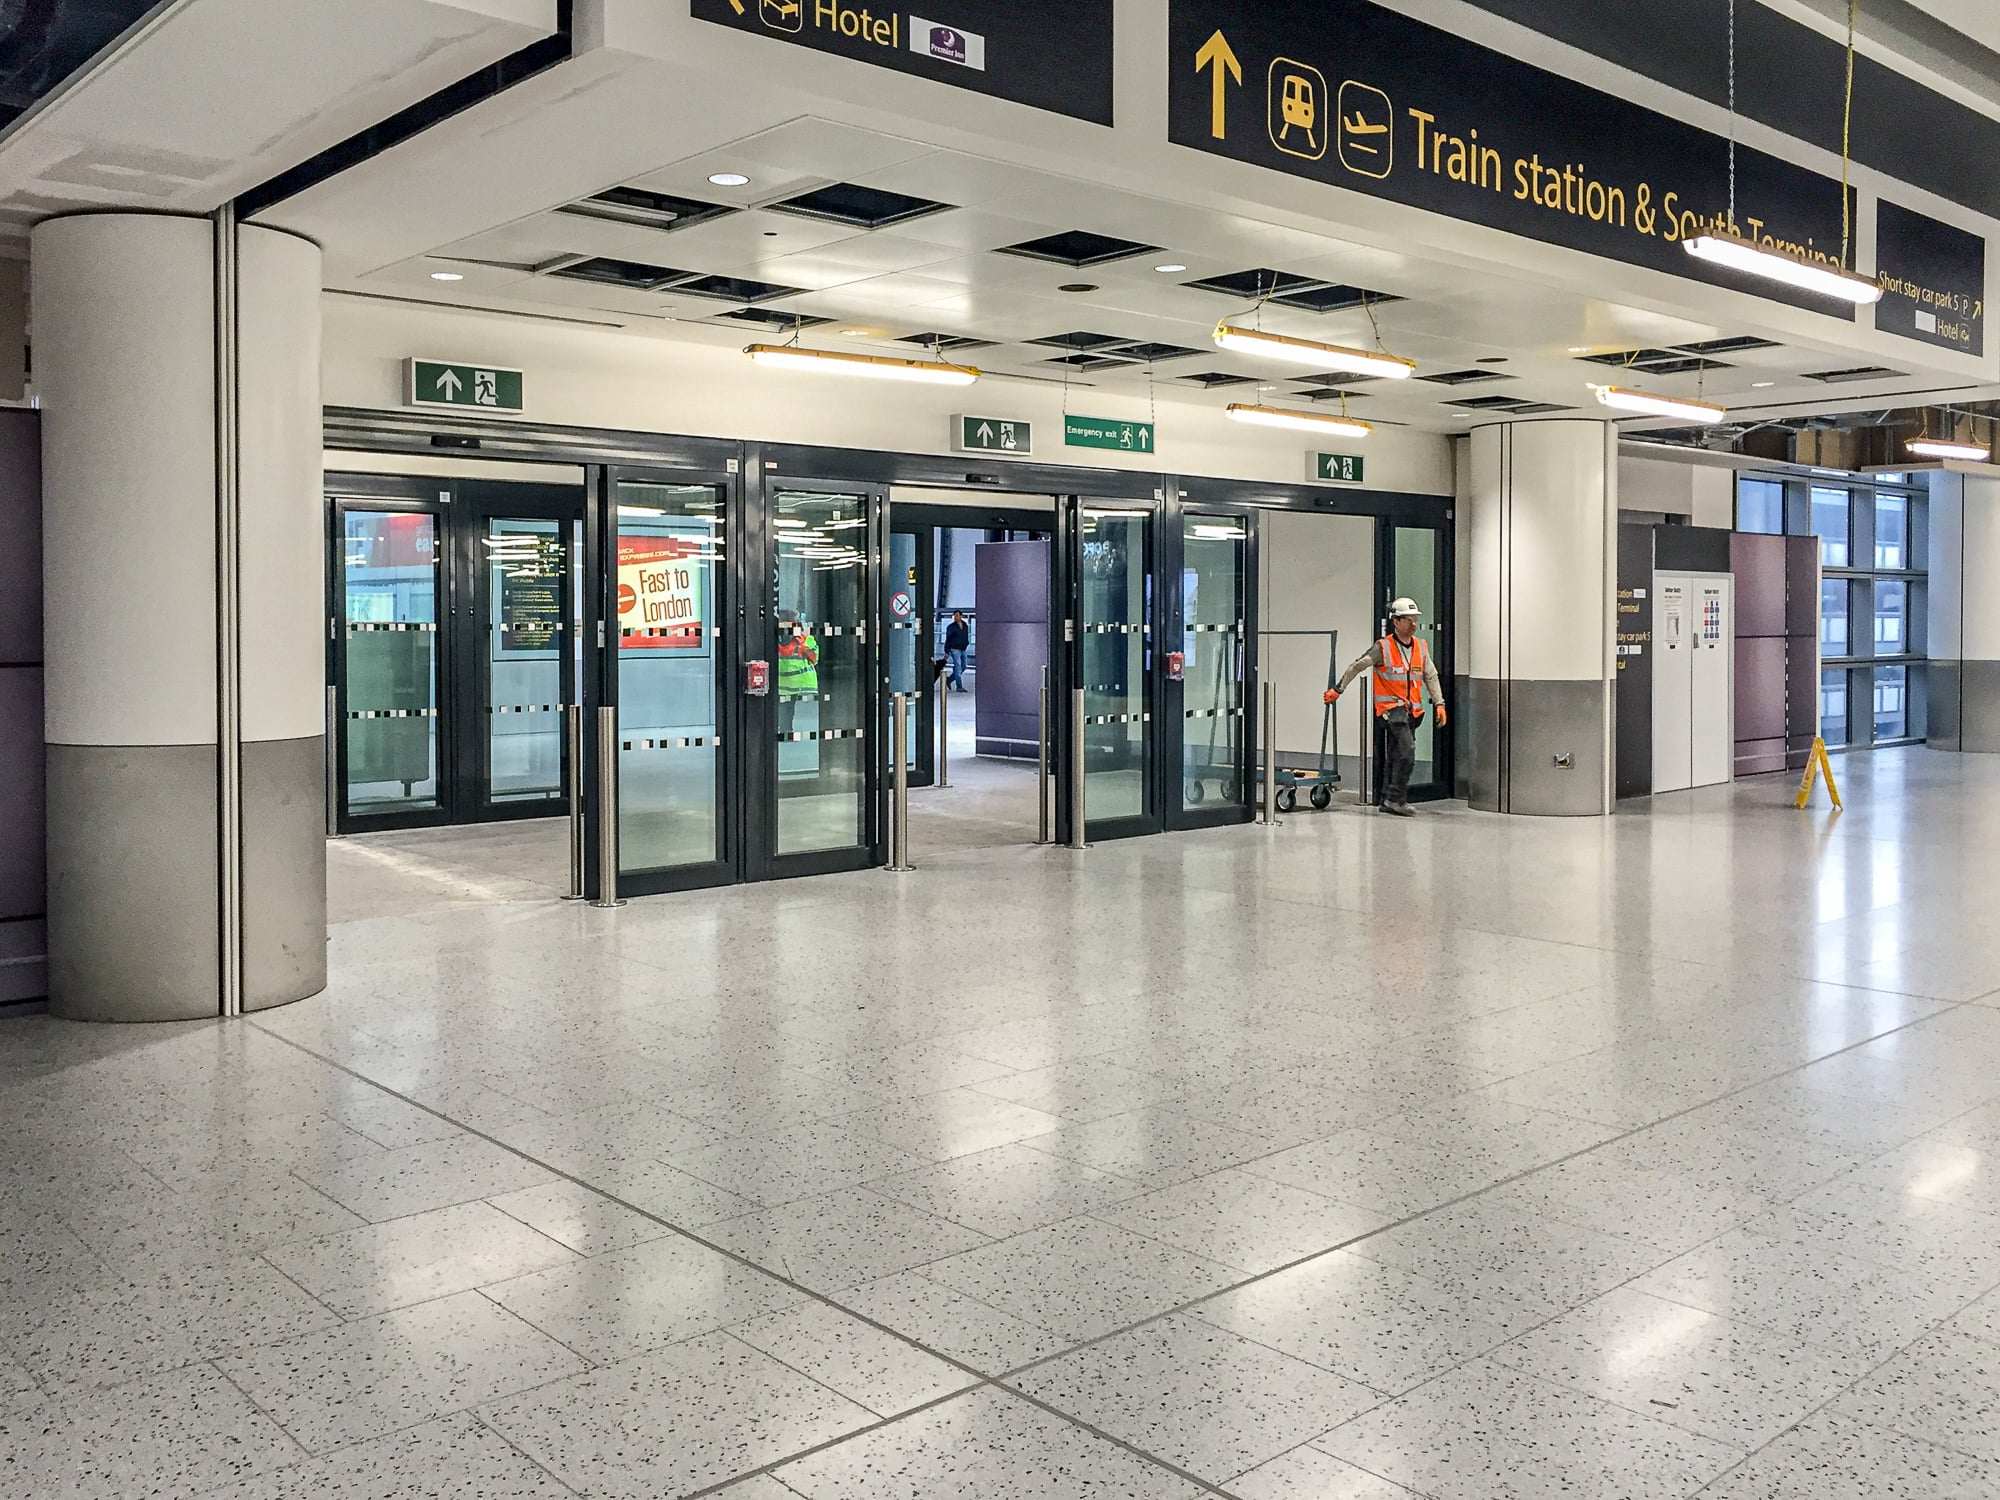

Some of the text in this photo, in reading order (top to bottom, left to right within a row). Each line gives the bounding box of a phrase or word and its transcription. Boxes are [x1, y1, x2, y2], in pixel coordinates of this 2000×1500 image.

[815, 0, 898, 49] Hotel
[931, 43, 965, 59] Premier Inn
[1408, 107, 1502, 192] Train
[1513, 154, 1625, 227] station
[1634, 182, 1656, 236] &
[1880, 270, 1903, 294] Short
[1904, 280, 1921, 303] stay
[1922, 288, 1934, 303] car
[1935, 291, 1953, 310] park
[1937, 318, 1959, 341] Hotel
[1067, 425, 1117, 439] Emergency exit
[639, 567, 689, 594] Fast to
[642, 594, 693, 623] London
